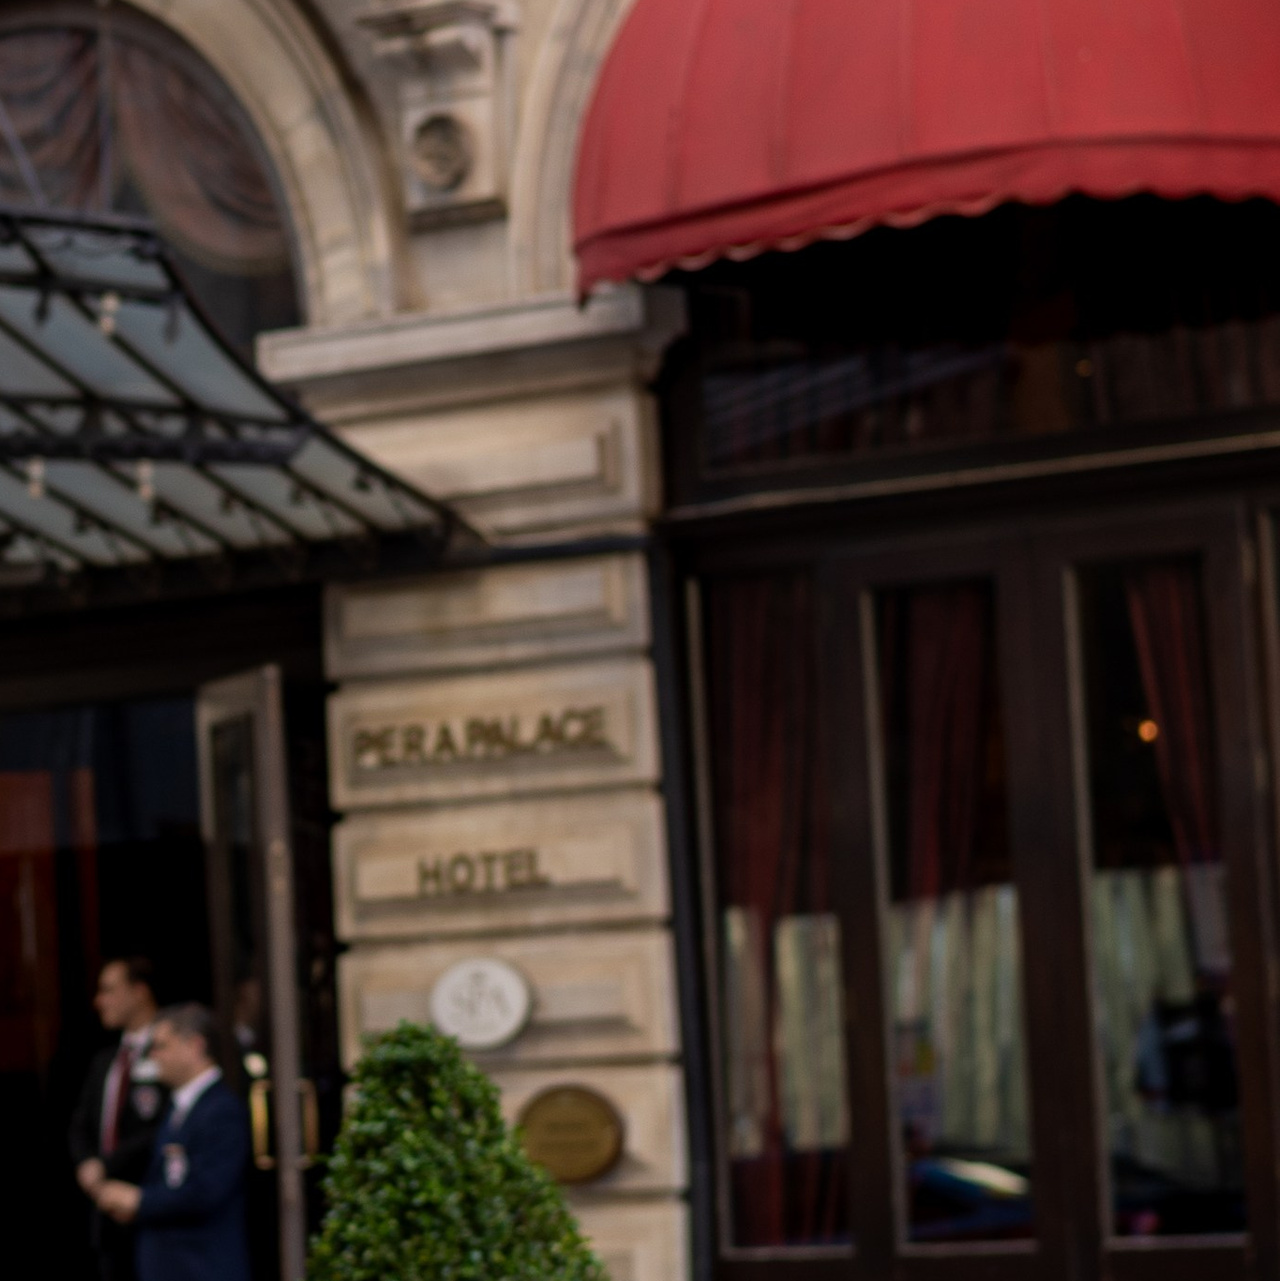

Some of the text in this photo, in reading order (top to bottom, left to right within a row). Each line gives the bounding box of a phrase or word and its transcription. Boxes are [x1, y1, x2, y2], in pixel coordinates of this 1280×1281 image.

[353, 706, 606, 766] PERA PALACE
[417, 848, 550, 896] HOTEL
